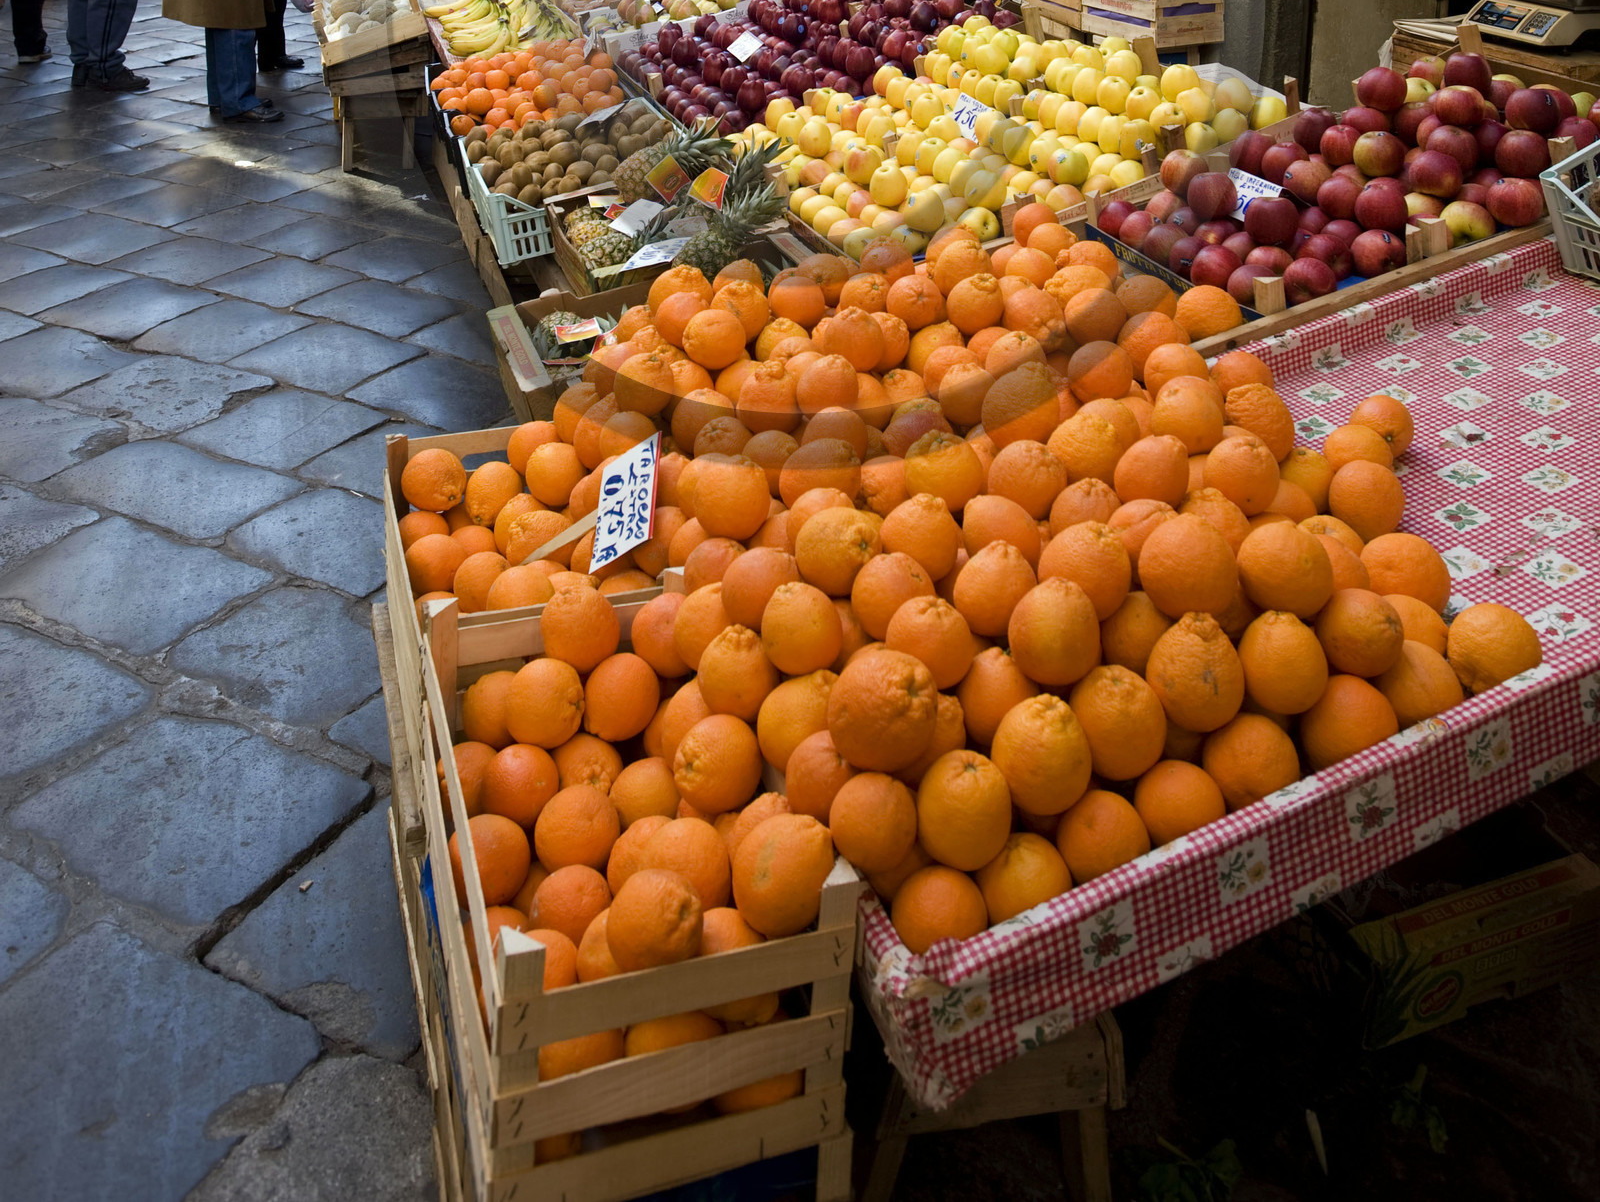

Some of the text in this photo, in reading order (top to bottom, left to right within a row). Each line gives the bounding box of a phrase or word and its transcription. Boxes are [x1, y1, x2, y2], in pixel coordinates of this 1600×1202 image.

[1452, 889, 1503, 915] MONTE
[1502, 876, 1541, 898] GOLD
[1441, 947, 1470, 963] DEL
[1470, 931, 1519, 954] MONTE
[1520, 915, 1558, 935] GOLD
